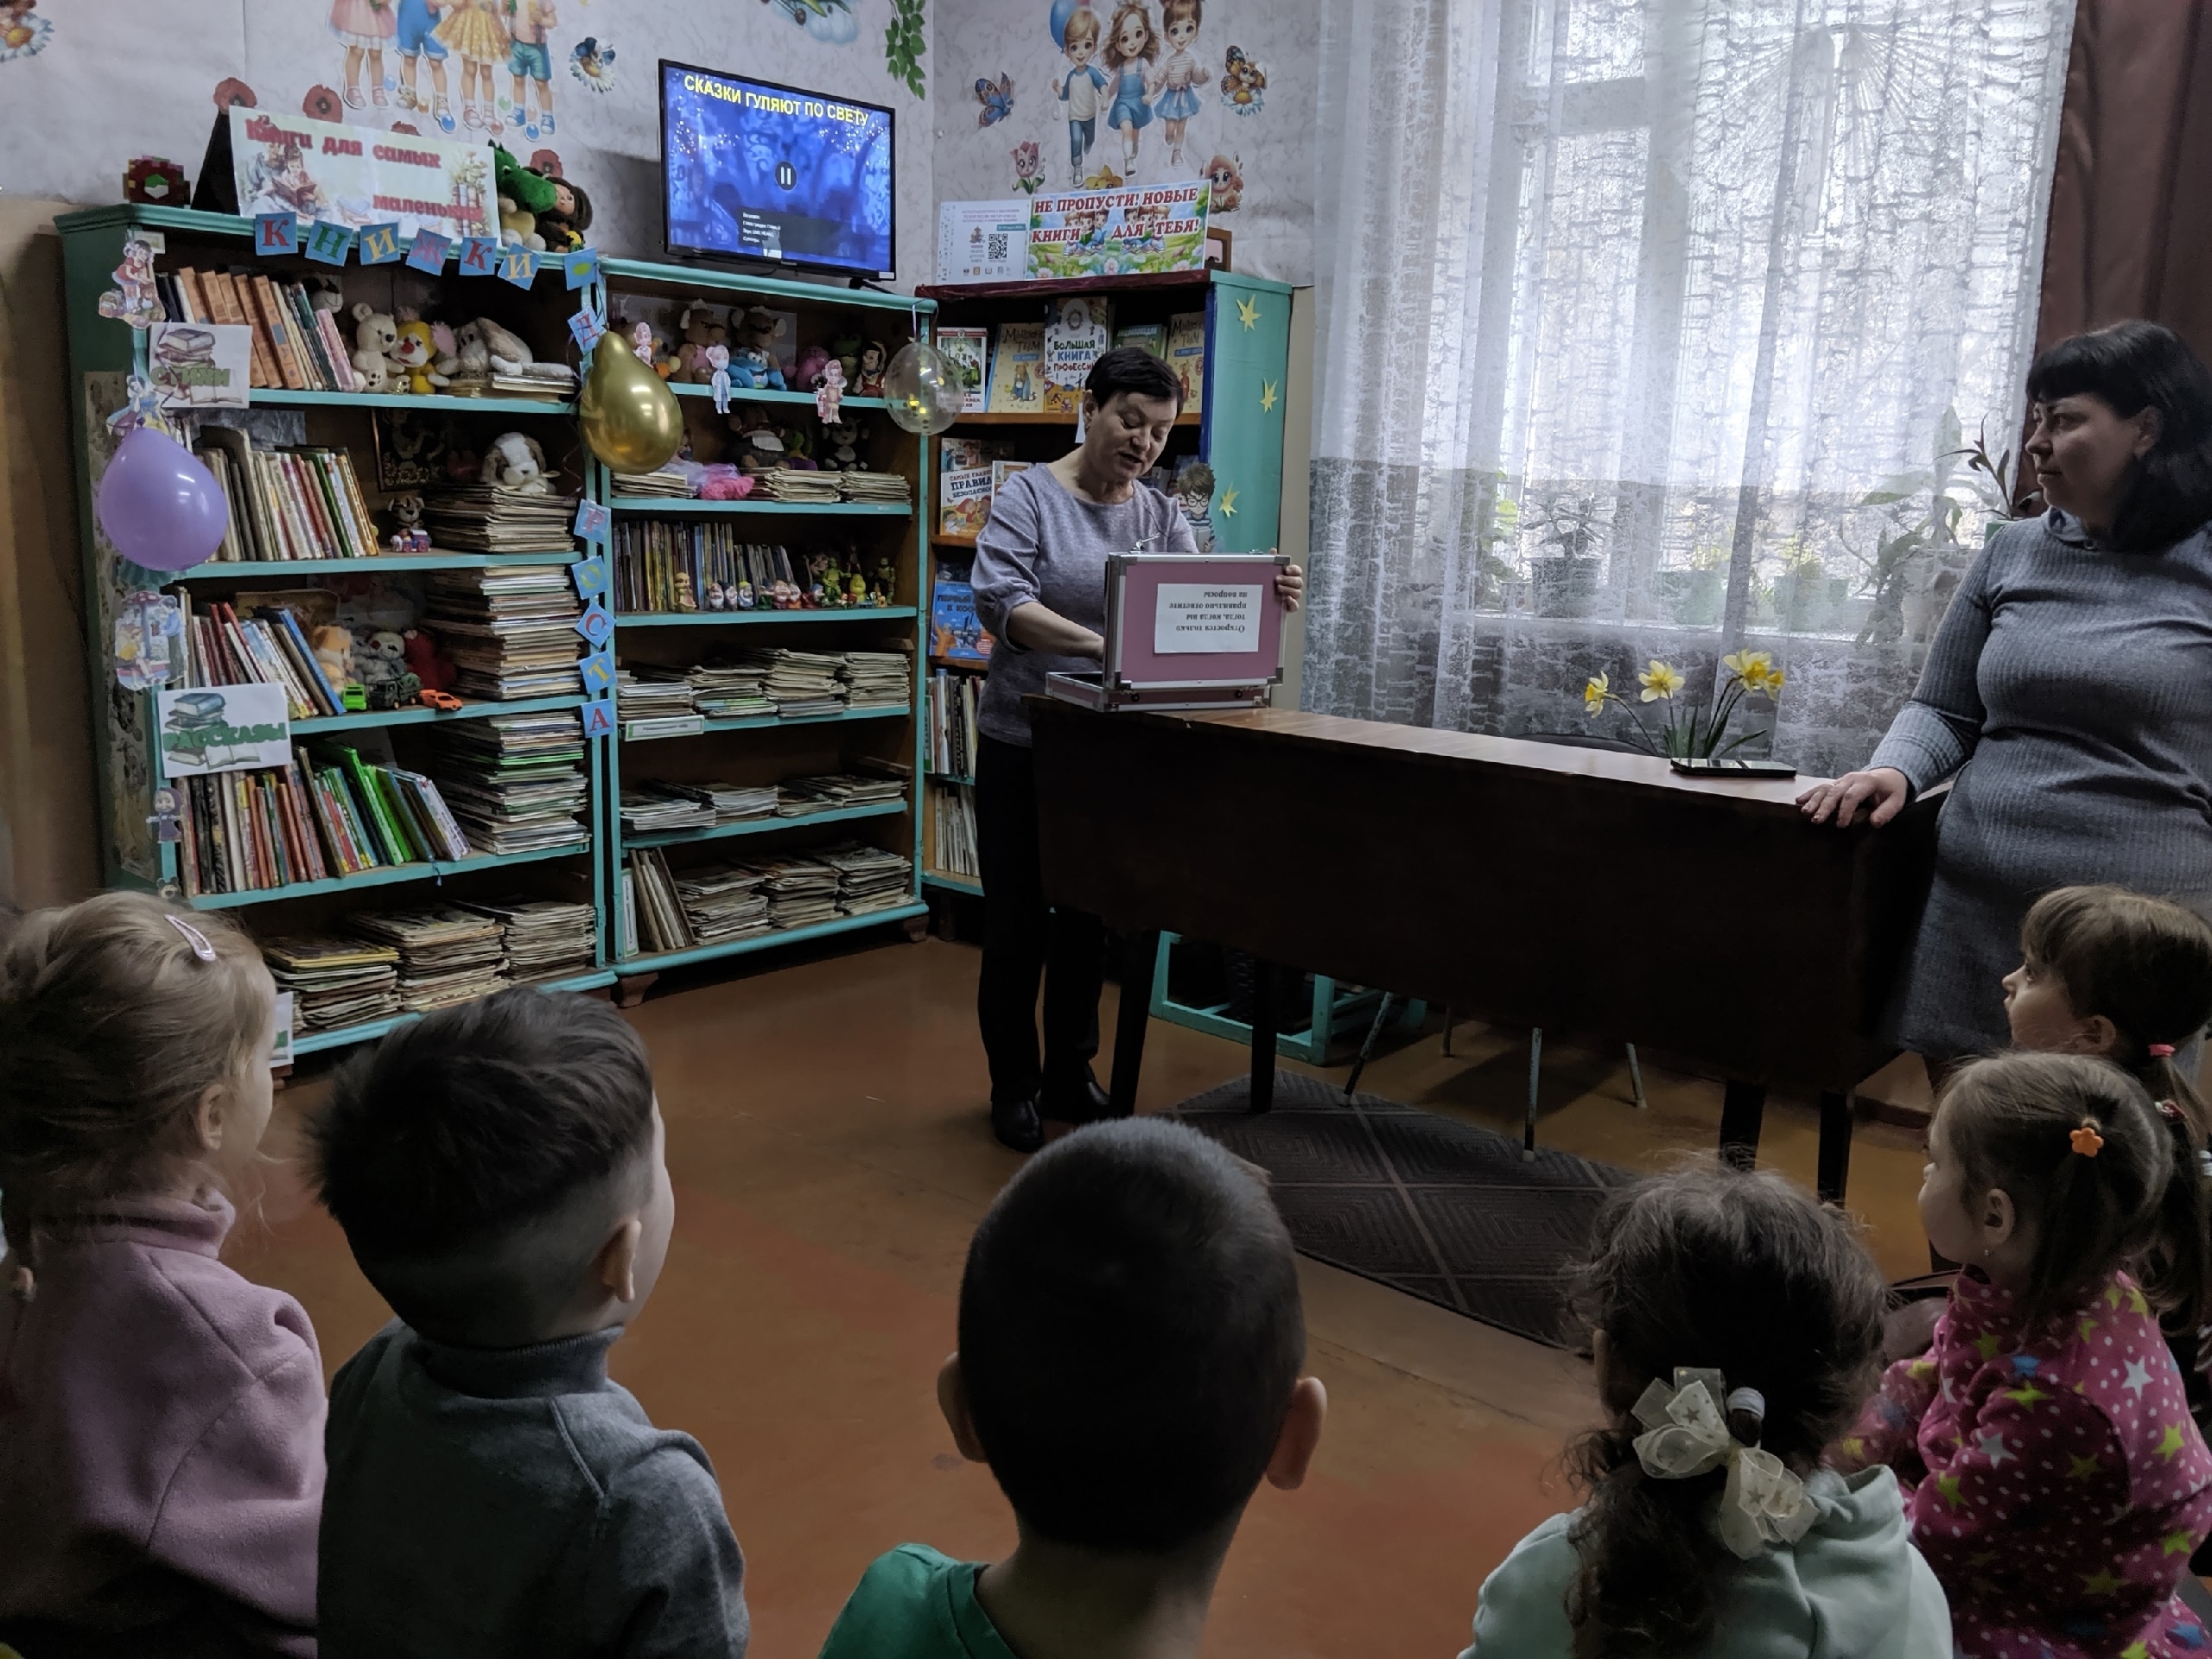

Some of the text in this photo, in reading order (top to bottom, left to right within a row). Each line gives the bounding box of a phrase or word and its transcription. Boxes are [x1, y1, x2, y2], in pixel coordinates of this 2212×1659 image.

[683, 74, 869, 127] СКАЗКИ ГУЛЯЮТ ПО СВЕТУ
[245, 115, 442, 168] Книги для самых
[1034, 188, 1198, 213] НЕ ПРОПУСТИ! НОВЫЕ
[1032, 219, 1199, 243] КНИГИ ДЛЯ ТЕБЯ!
[1057, 351, 1091, 361] КНИГА
[150, 365, 231, 387] СТИХИ
[950, 476, 993, 491] ПРАВИЛ
[1204, 589, 1237, 598] вопросы
[1205, 624, 1245, 633] Откроется
